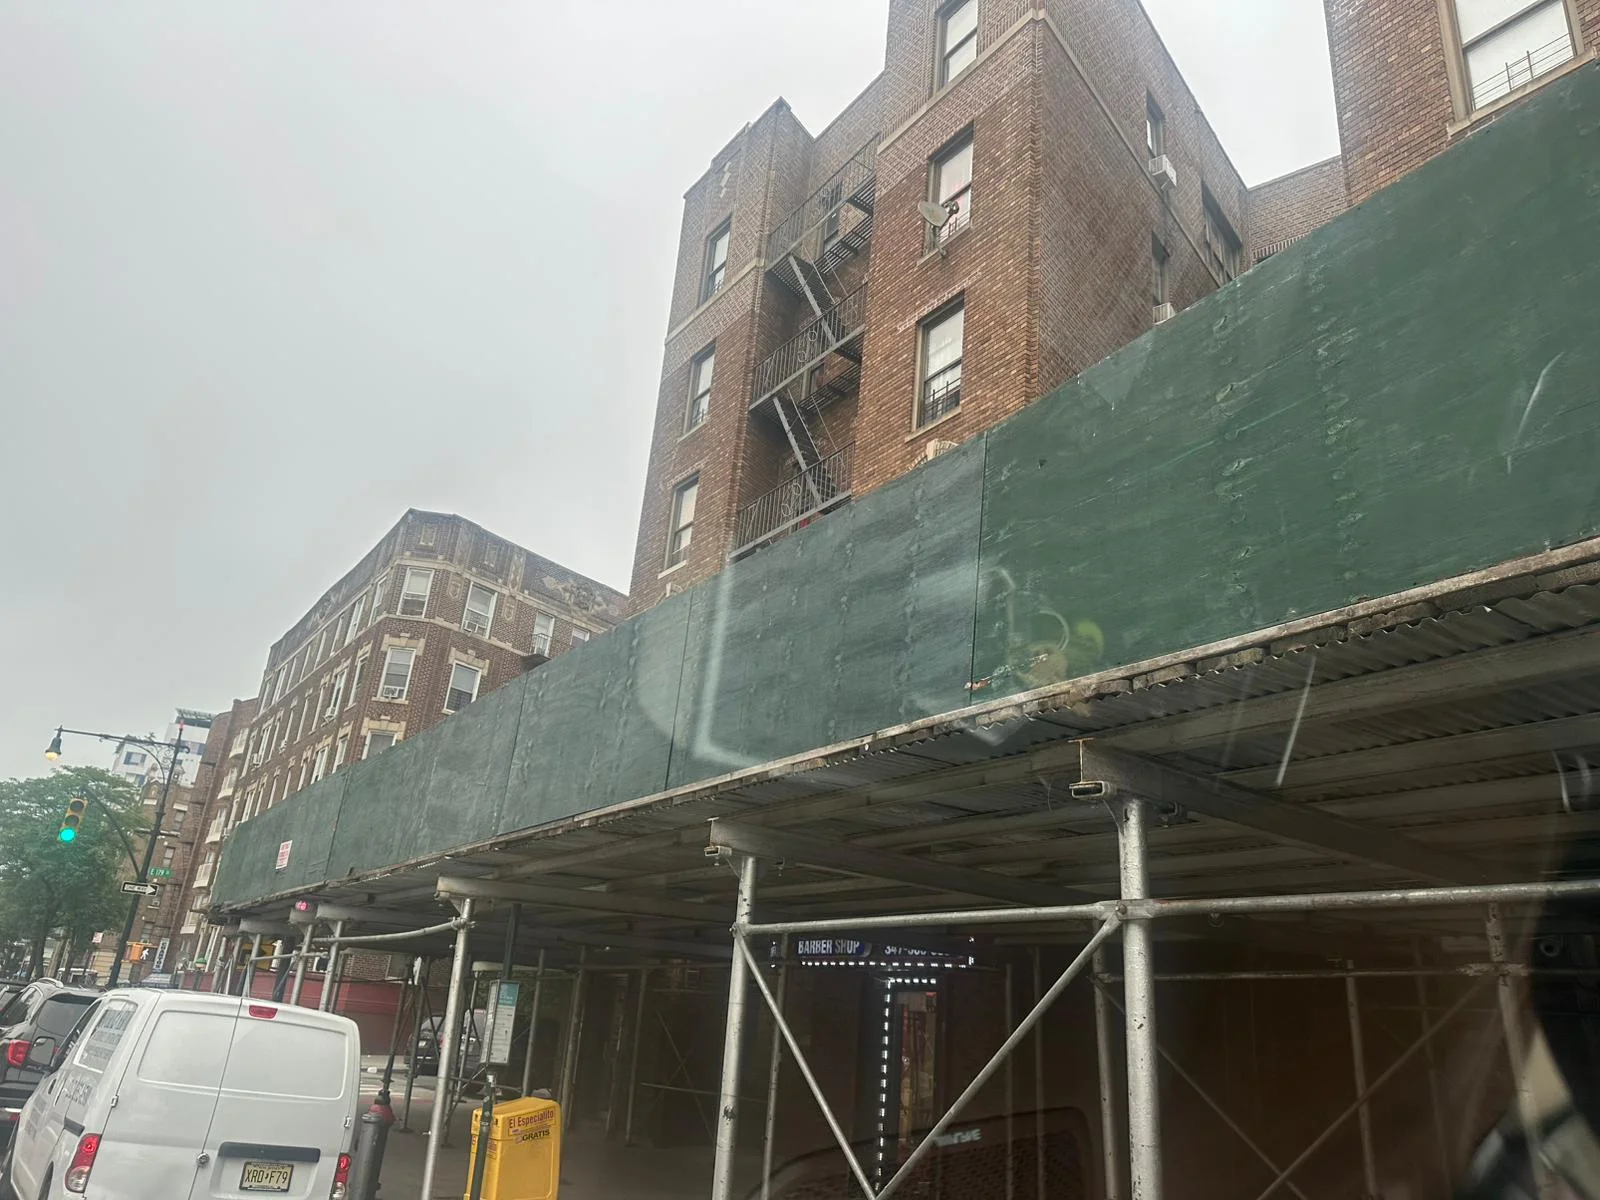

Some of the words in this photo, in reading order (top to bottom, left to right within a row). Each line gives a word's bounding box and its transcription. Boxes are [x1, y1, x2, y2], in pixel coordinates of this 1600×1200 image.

[798, 939, 833, 955] BARBER
[509, 1118, 516, 1128] El
[518, 1109, 554, 1127] Especialito
[522, 1129, 550, 1141] GRATIS
